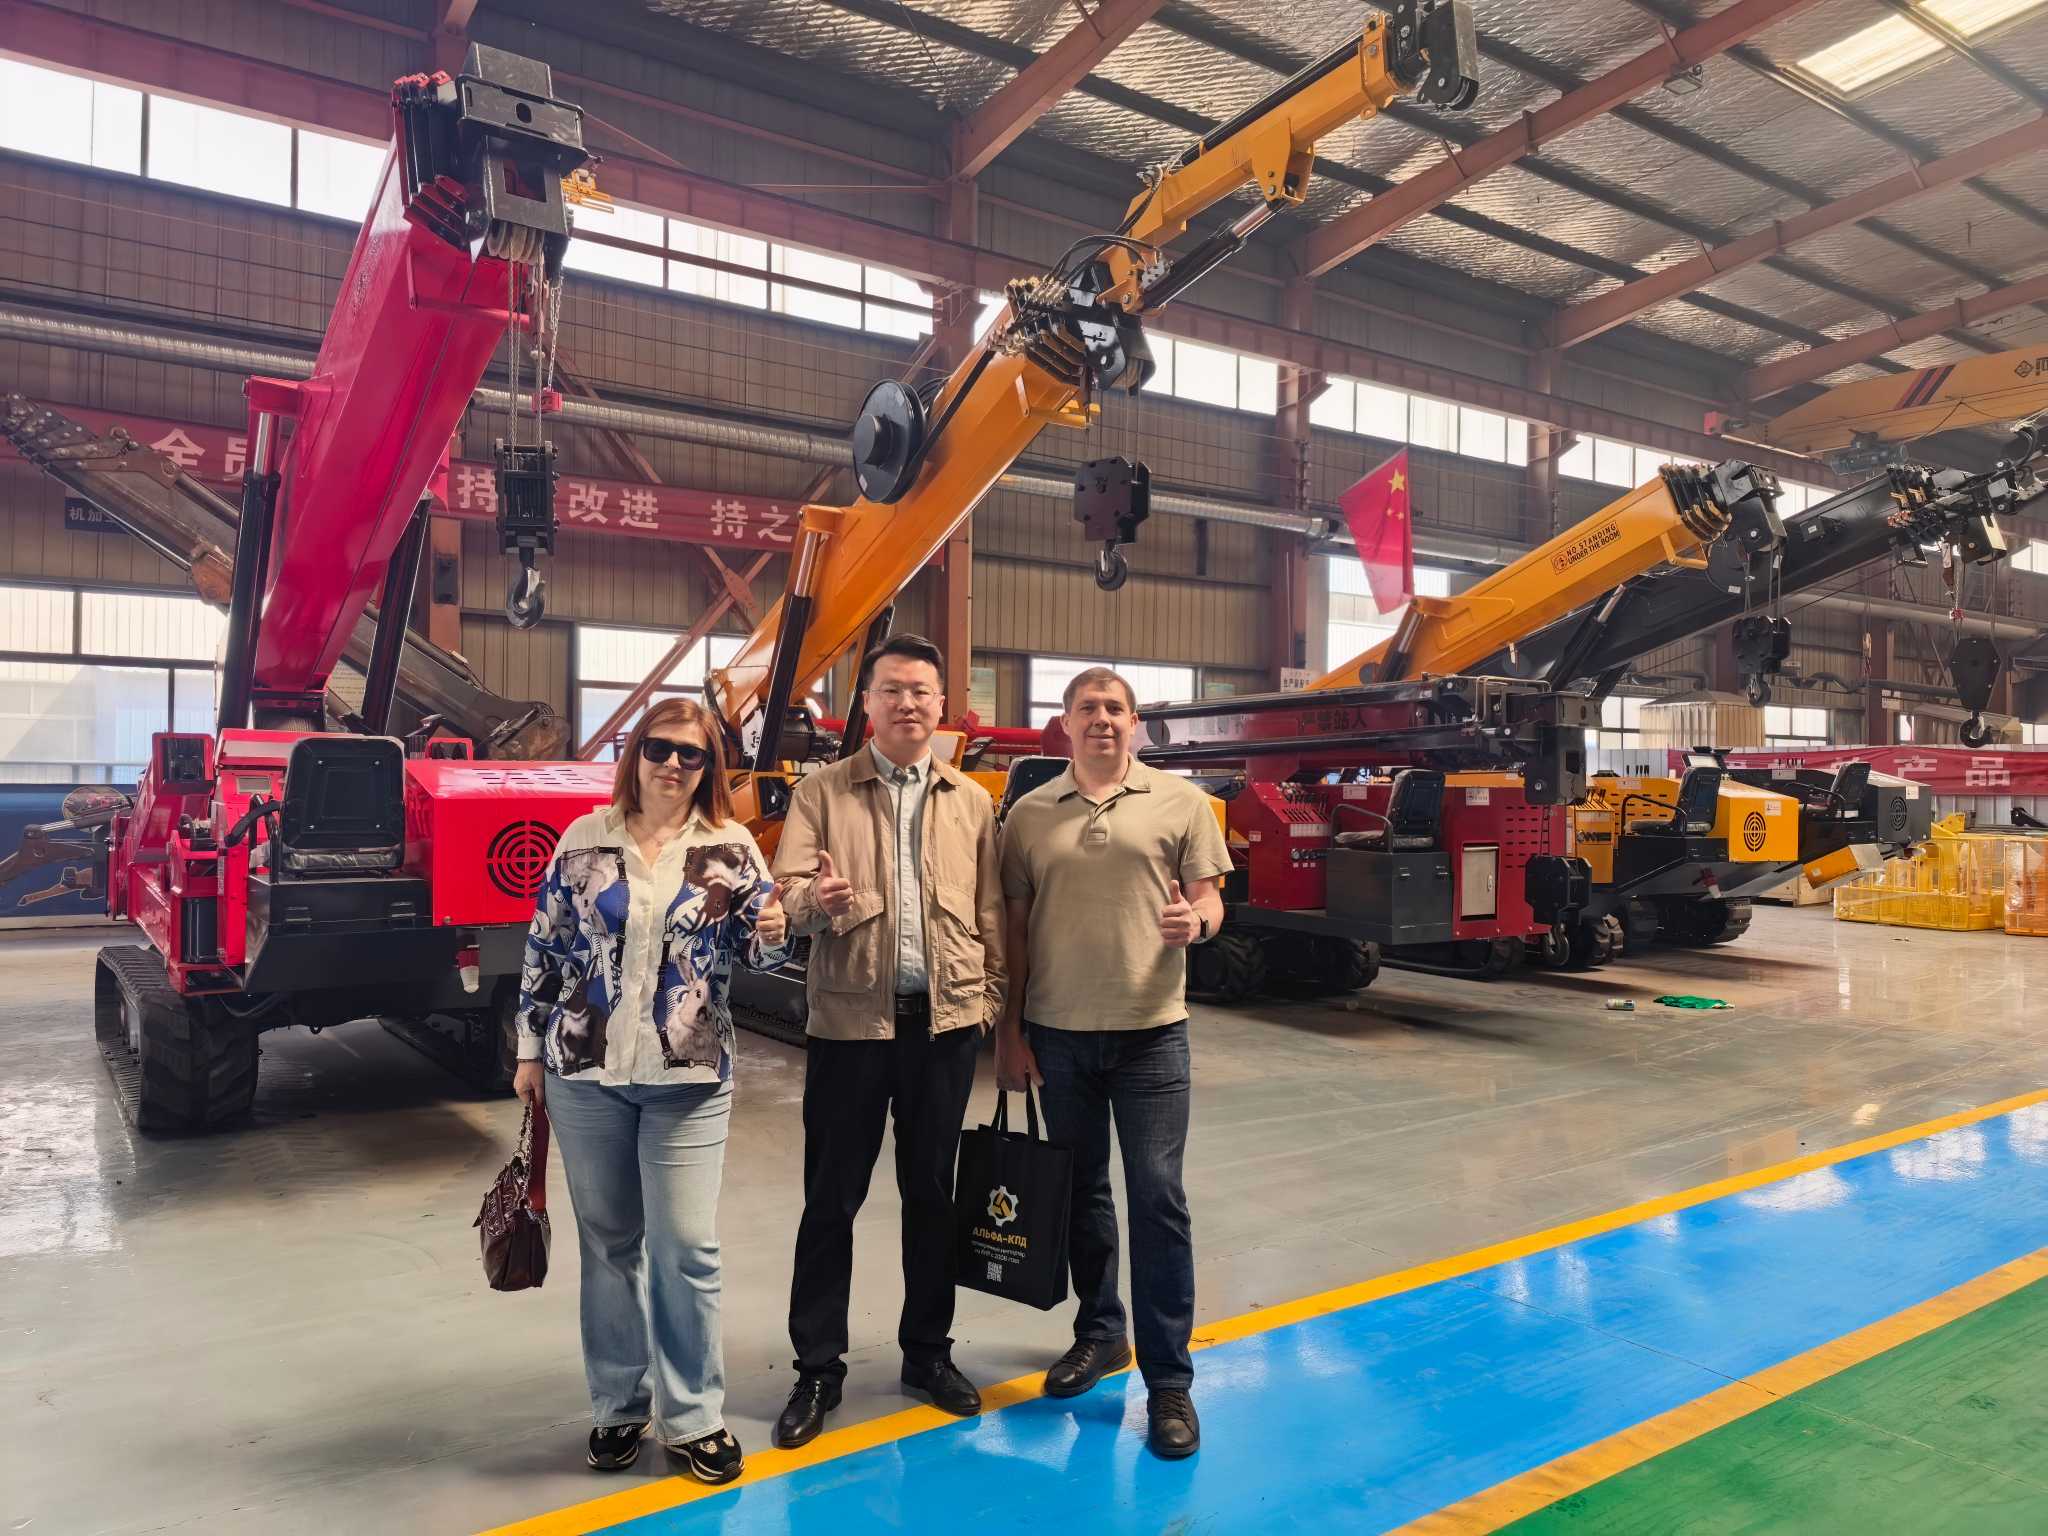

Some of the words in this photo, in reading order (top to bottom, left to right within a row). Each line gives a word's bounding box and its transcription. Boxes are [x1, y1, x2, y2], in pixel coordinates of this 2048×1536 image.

[1566, 546, 1577, 557] NO
[1579, 522, 1617, 549] STANDING
[1567, 548, 1589, 564] UNDER
[1601, 530, 1620, 547] BOOM
